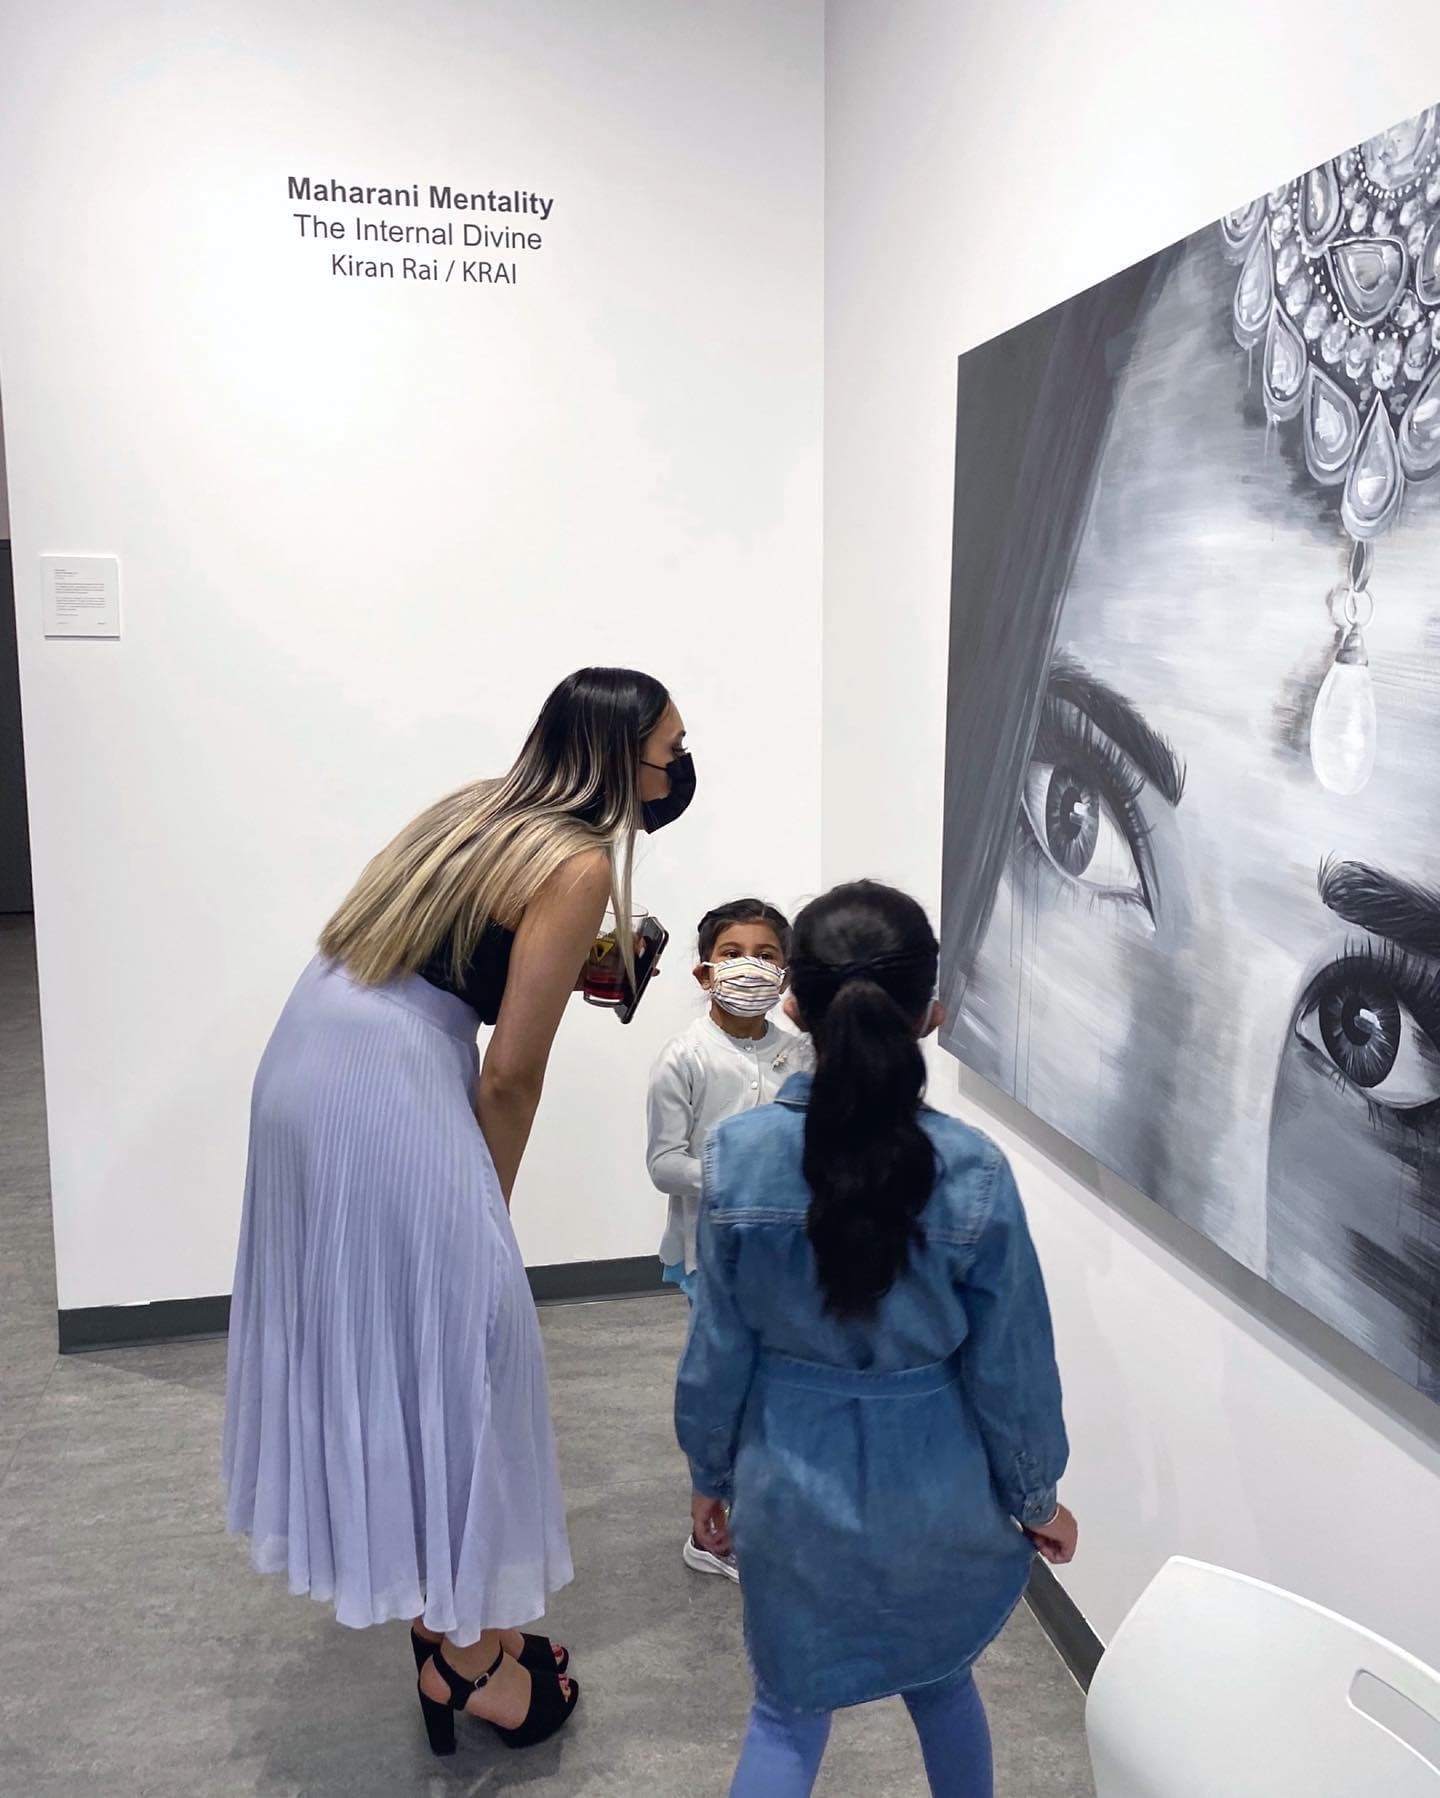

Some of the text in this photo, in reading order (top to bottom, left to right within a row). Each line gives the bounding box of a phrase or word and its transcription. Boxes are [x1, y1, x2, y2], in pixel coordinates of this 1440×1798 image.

[288, 176, 554, 220] Maharani Mentality
[293, 213, 542, 250] The Internal Divine
[332, 253, 516, 284] Kiran Rai / KRAI
